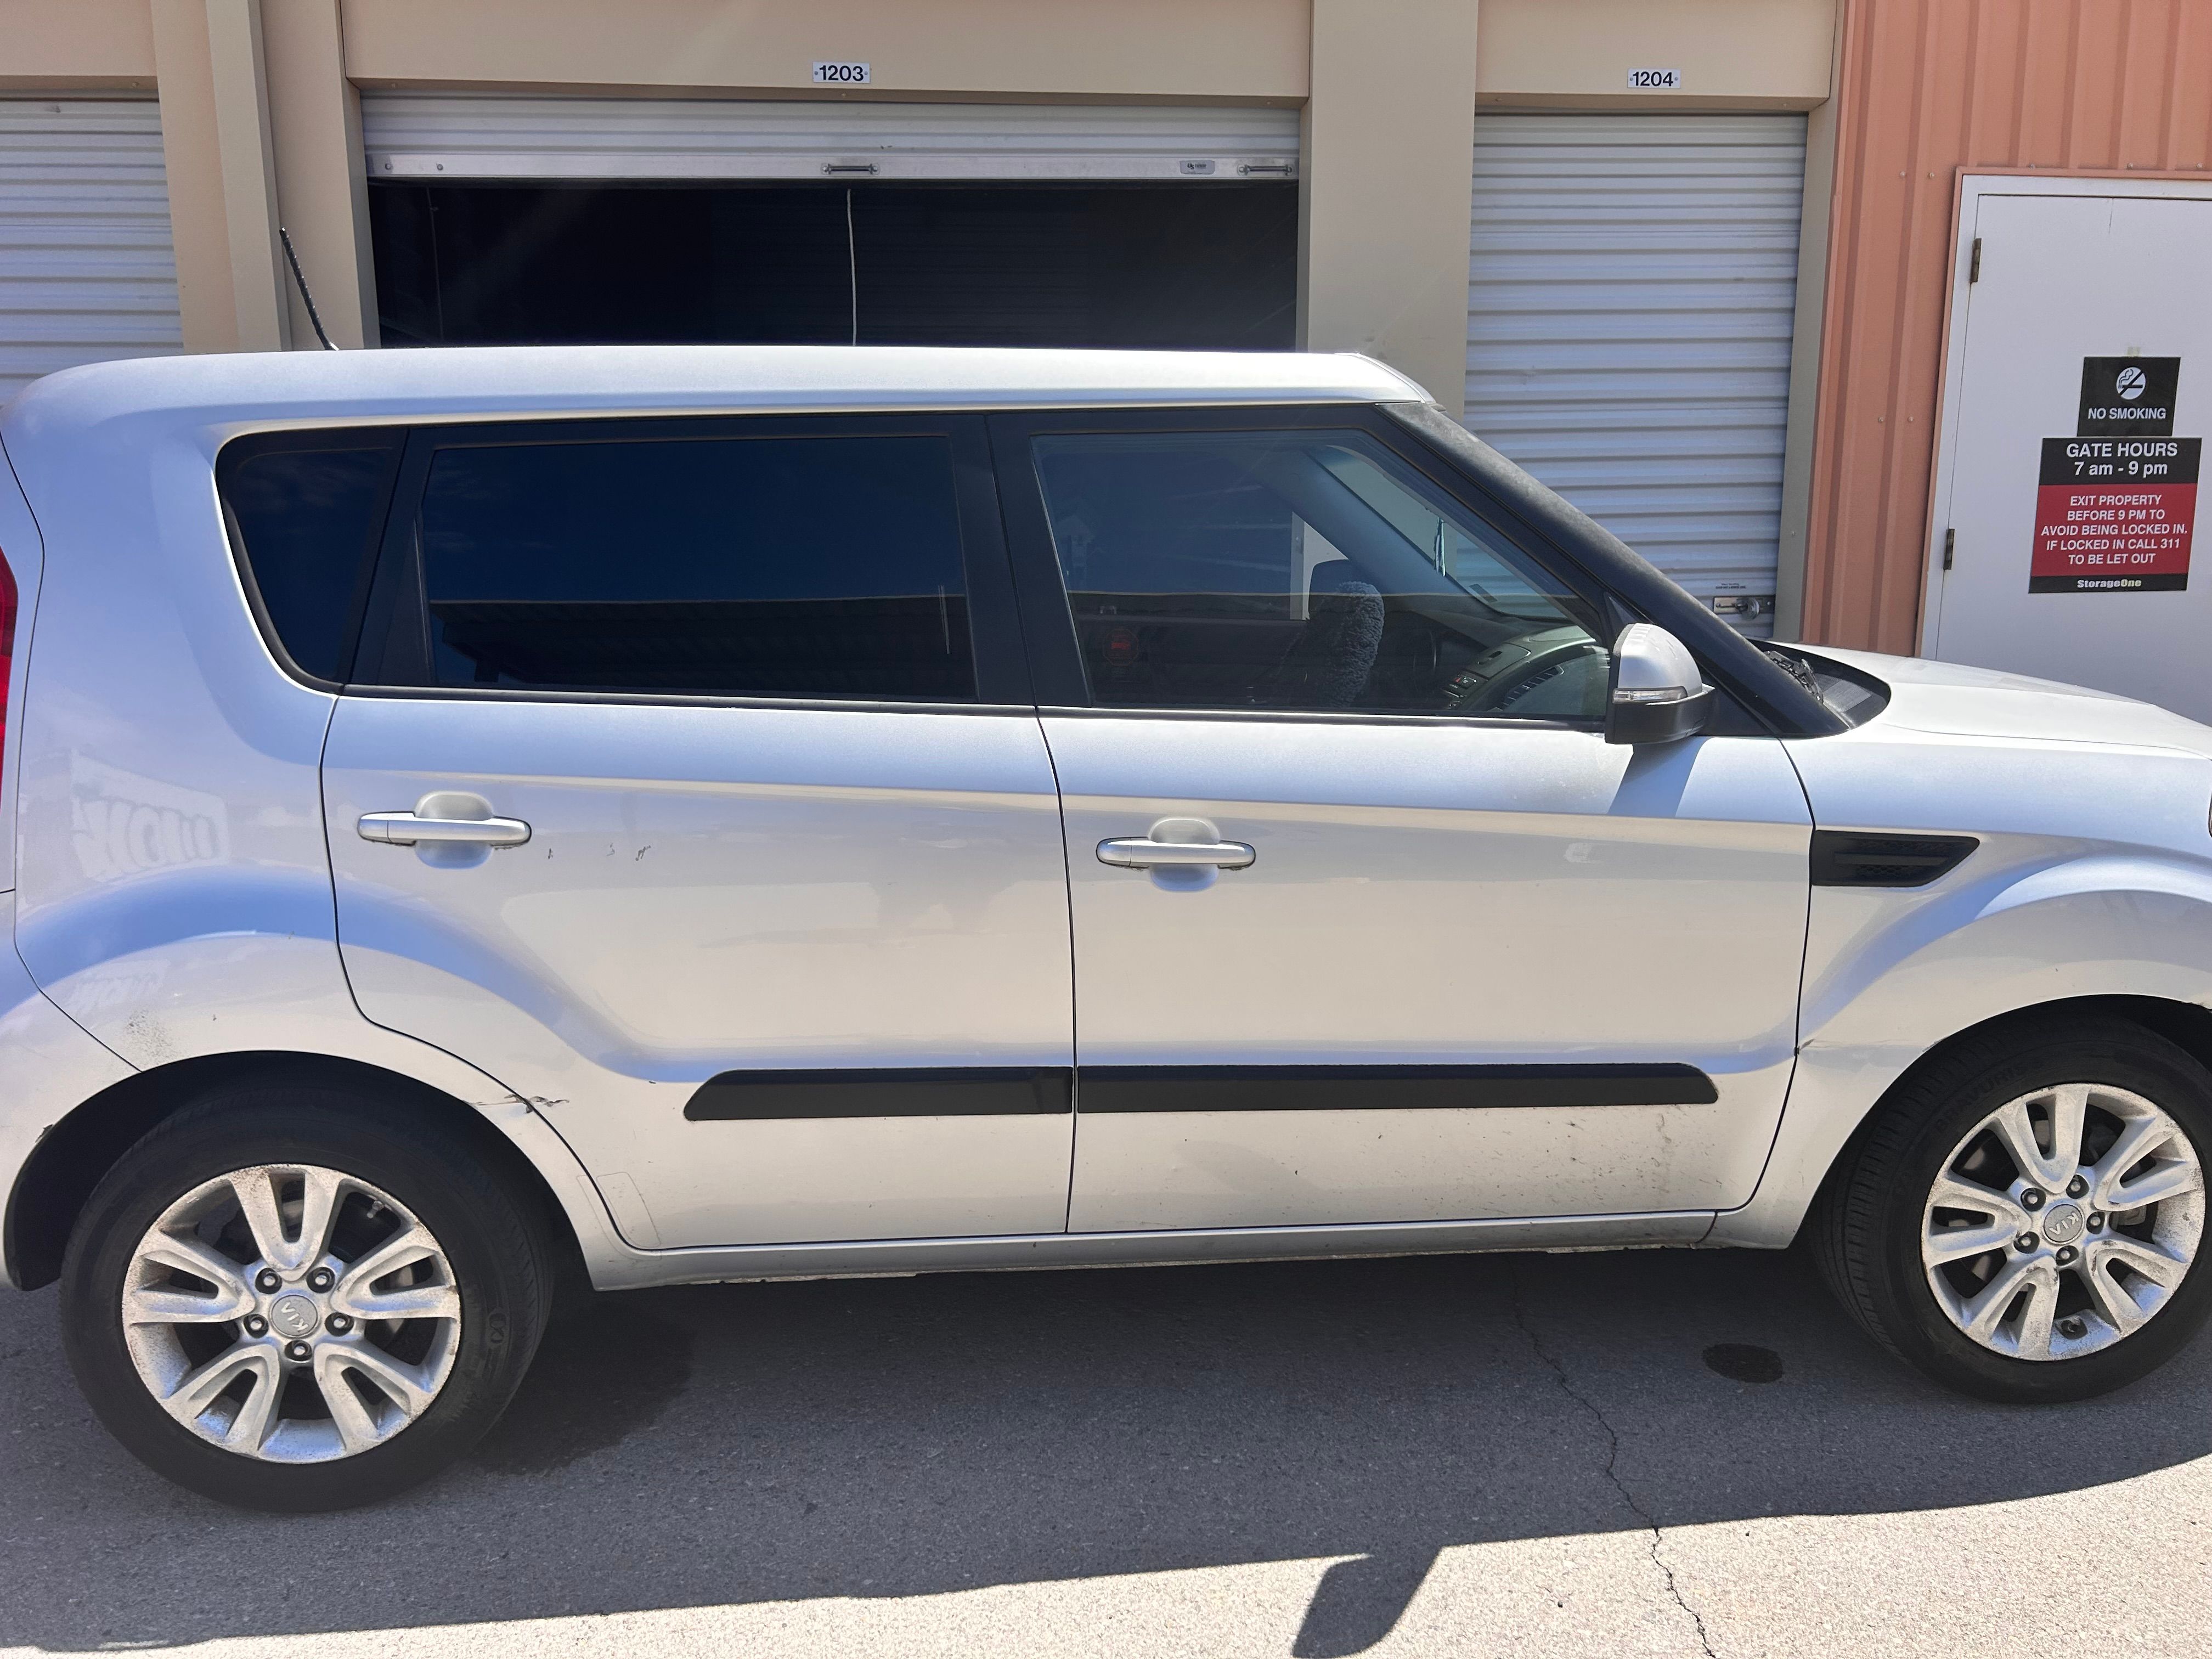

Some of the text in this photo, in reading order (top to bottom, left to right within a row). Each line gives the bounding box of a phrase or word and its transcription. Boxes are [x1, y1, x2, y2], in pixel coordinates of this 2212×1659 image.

[819, 65, 864, 82] 1203
[1632, 71, 1673, 87] 1204
[2088, 408, 2166, 419] NO SMOKING
[2066, 442, 2178, 458] GATE HOURS
[2074, 461, 2085, 476] 7
[2089, 463, 2113, 476] am
[2128, 460, 2138, 475] 9
[2143, 462, 2168, 478] pm
[2070, 494, 2162, 506] EXIT PROPERTY
[2067, 509, 2165, 521] BEFORE 9 PM TO
[2041, 523, 2188, 536] AVOID BEING LOCKED IN.
[2046, 538, 2180, 551] IF LOCKED IN CALL 311
[2068, 552, 2156, 565] TO BE LET OUT
[2077, 578, 2142, 589] StorageOne
[2049, 1212, 2079, 1235] KIA
[280, 1301, 309, 1331] KIA
